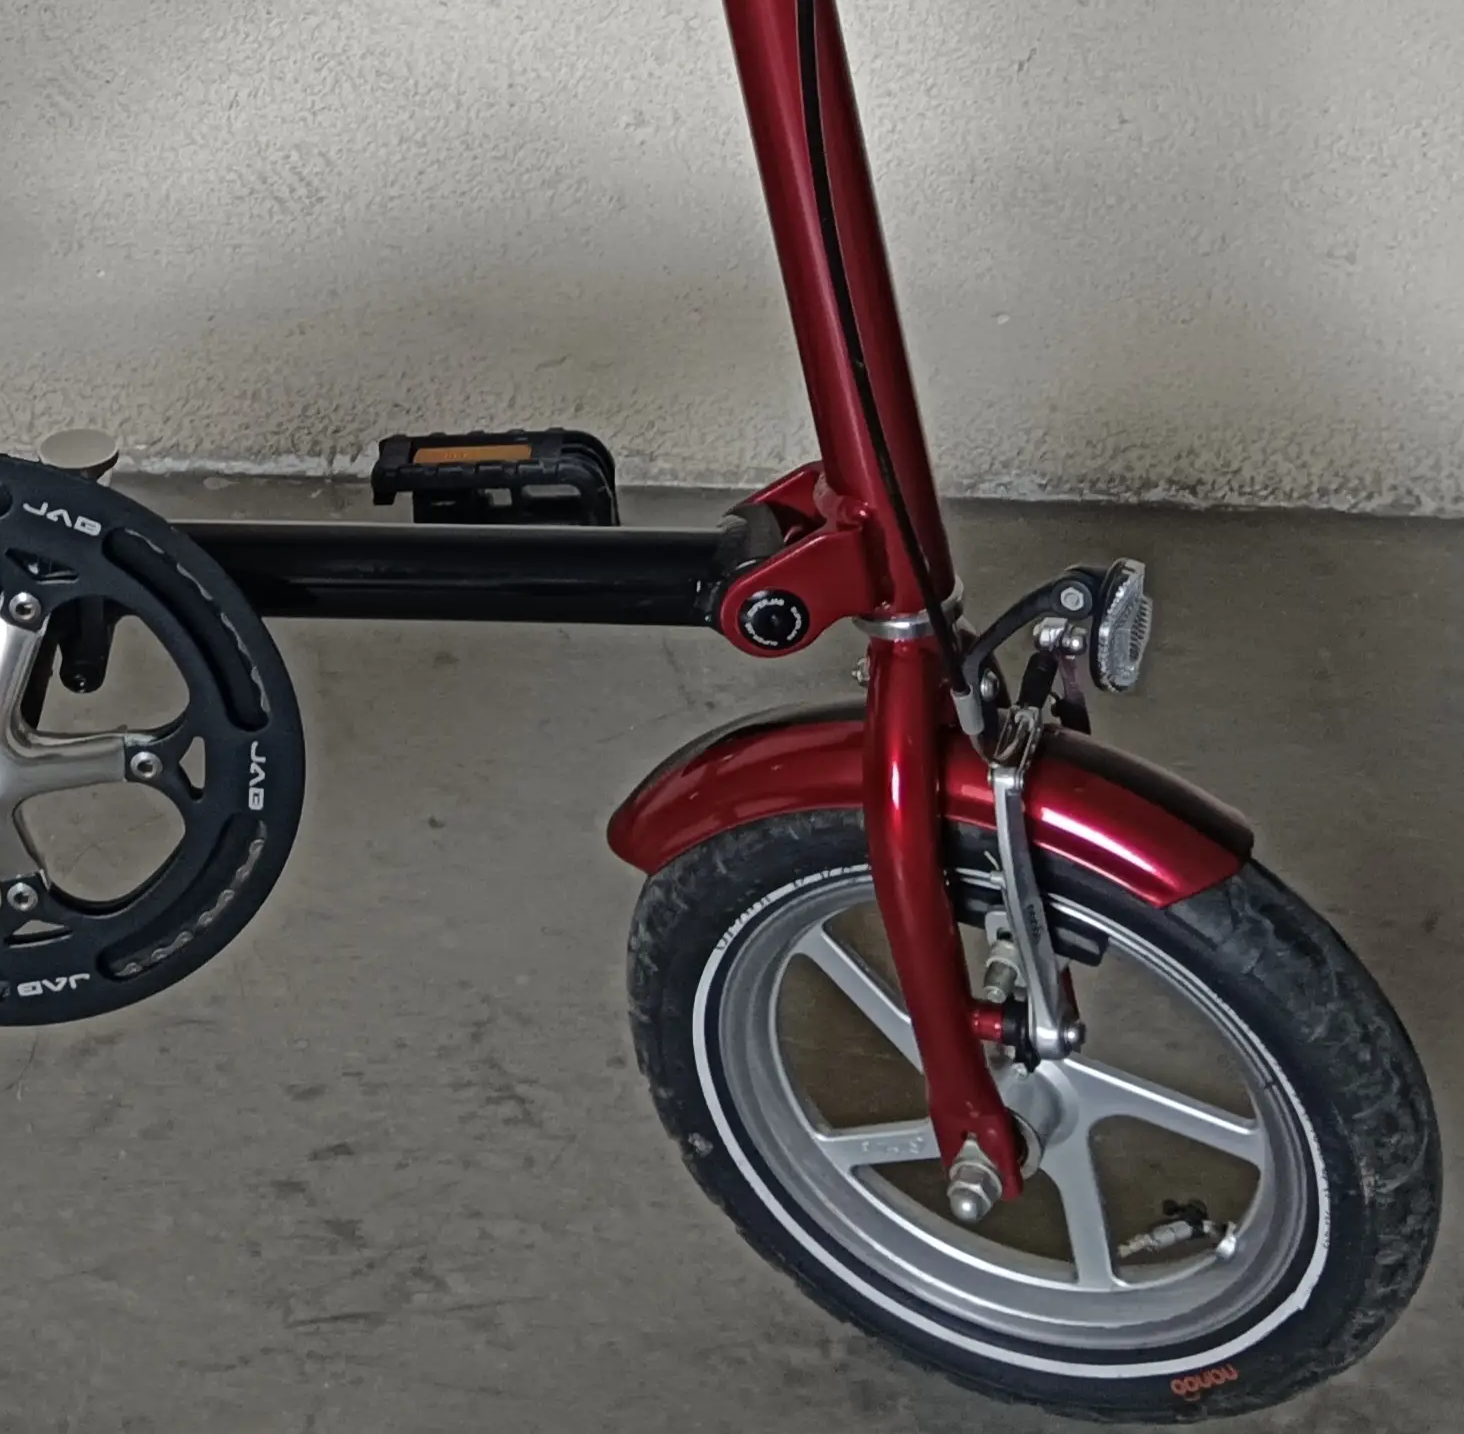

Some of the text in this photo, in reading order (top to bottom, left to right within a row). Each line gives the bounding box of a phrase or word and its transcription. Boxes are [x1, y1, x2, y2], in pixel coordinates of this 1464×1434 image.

[22, 501, 102, 536] JAB
[248, 740, 267, 811] JAB
[16, 972, 91, 997] JAB
